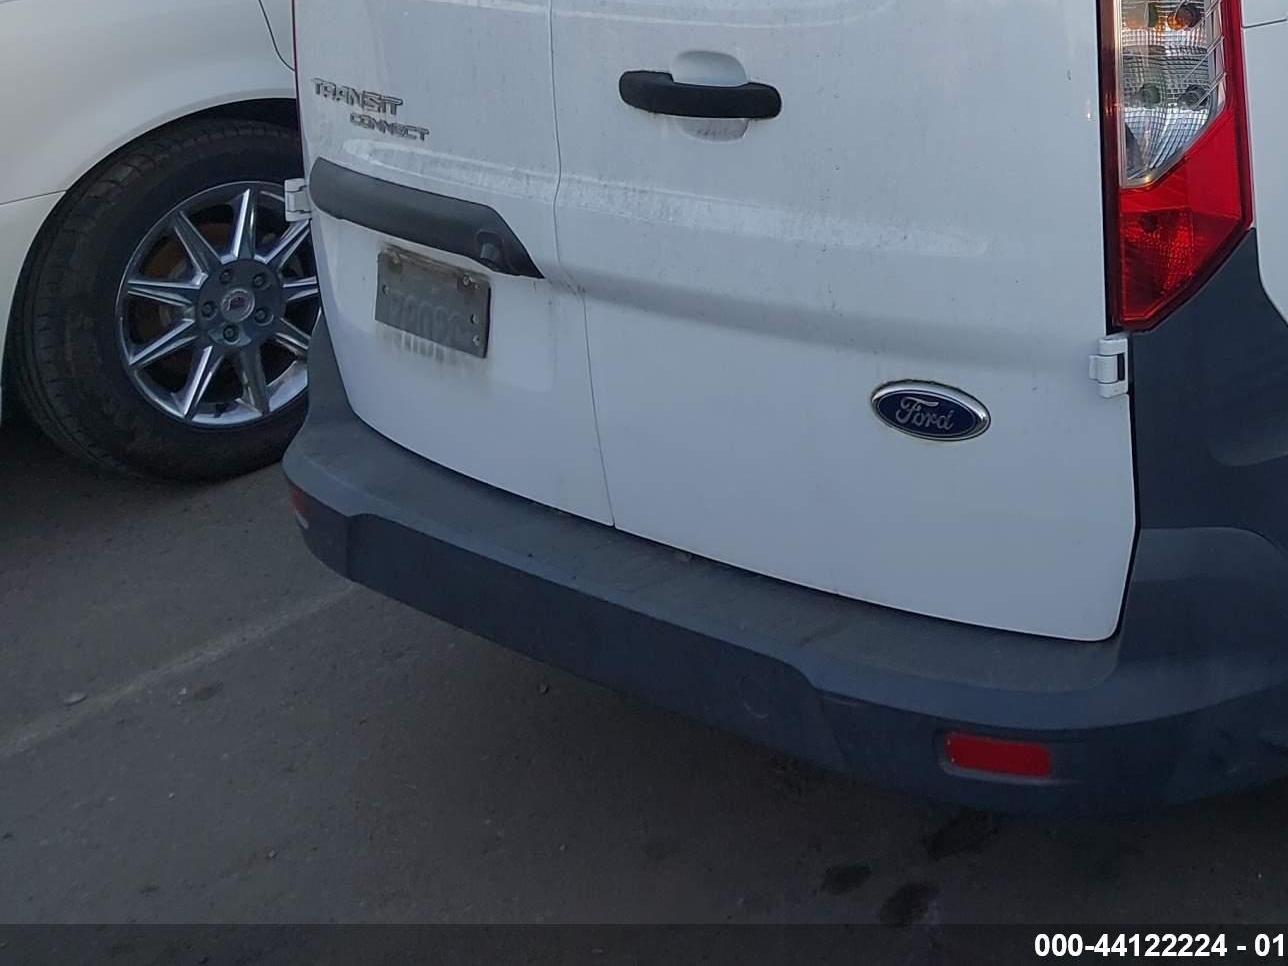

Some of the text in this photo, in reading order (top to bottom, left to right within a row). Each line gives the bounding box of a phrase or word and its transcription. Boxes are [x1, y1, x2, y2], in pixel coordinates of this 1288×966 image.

[311, 77, 404, 116] TRANSIT
[350, 112, 430, 142] CONNECT
[895, 396, 955, 431] Ford
